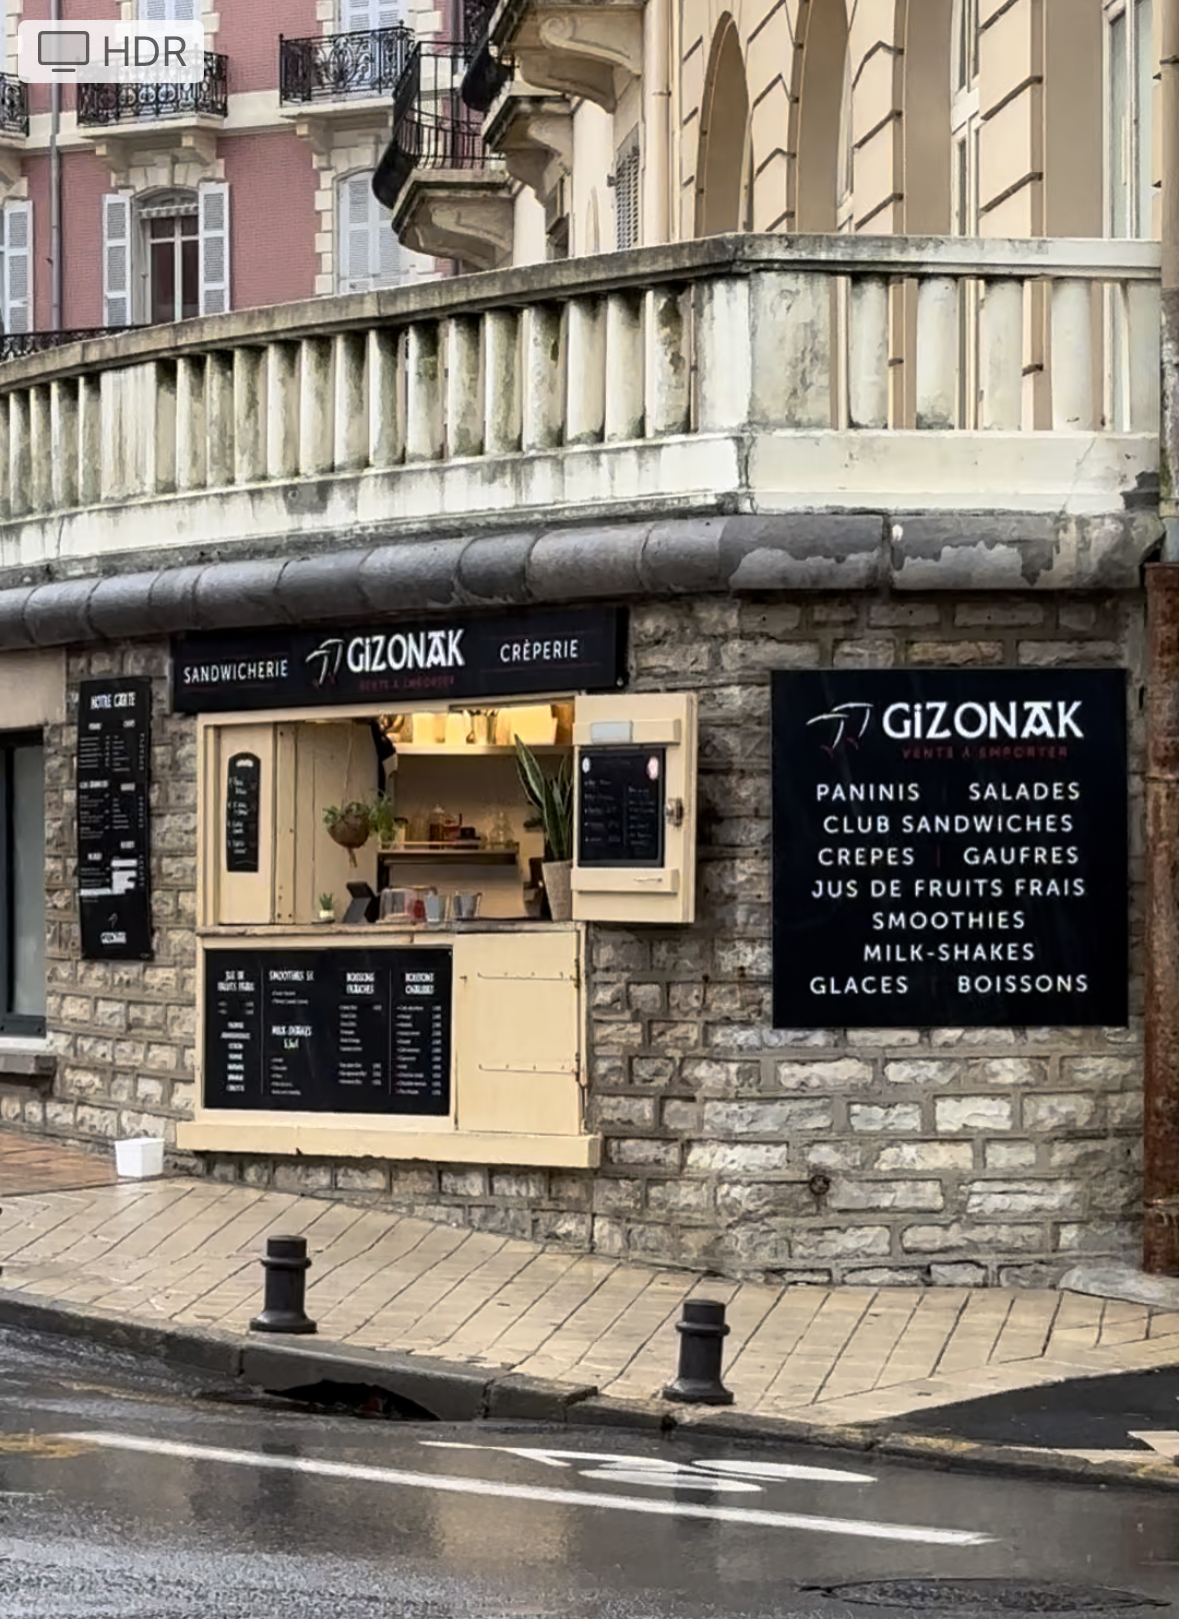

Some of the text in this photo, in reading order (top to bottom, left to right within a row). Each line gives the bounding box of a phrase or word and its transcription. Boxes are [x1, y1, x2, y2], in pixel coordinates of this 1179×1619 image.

[184, 659, 288, 684] SANDWICHERIE
[816, 782, 920, 801] PANINIS
[968, 782, 1080, 801] SALADES
[823, 814, 1073, 834] CLUB SANDWICHES
[817, 847, 915, 866] CREPES
[963, 846, 1079, 865] GAUFRES
[811, 878, 1085, 898] JUS DE FRUITS FRAIS
[872, 911, 1025, 930] SMOOTHIES
[863, 943, 1035, 961] MILK-SHAKES
[809, 976, 909, 994] GLACES
[957, 974, 1088, 993] BOISSONS
